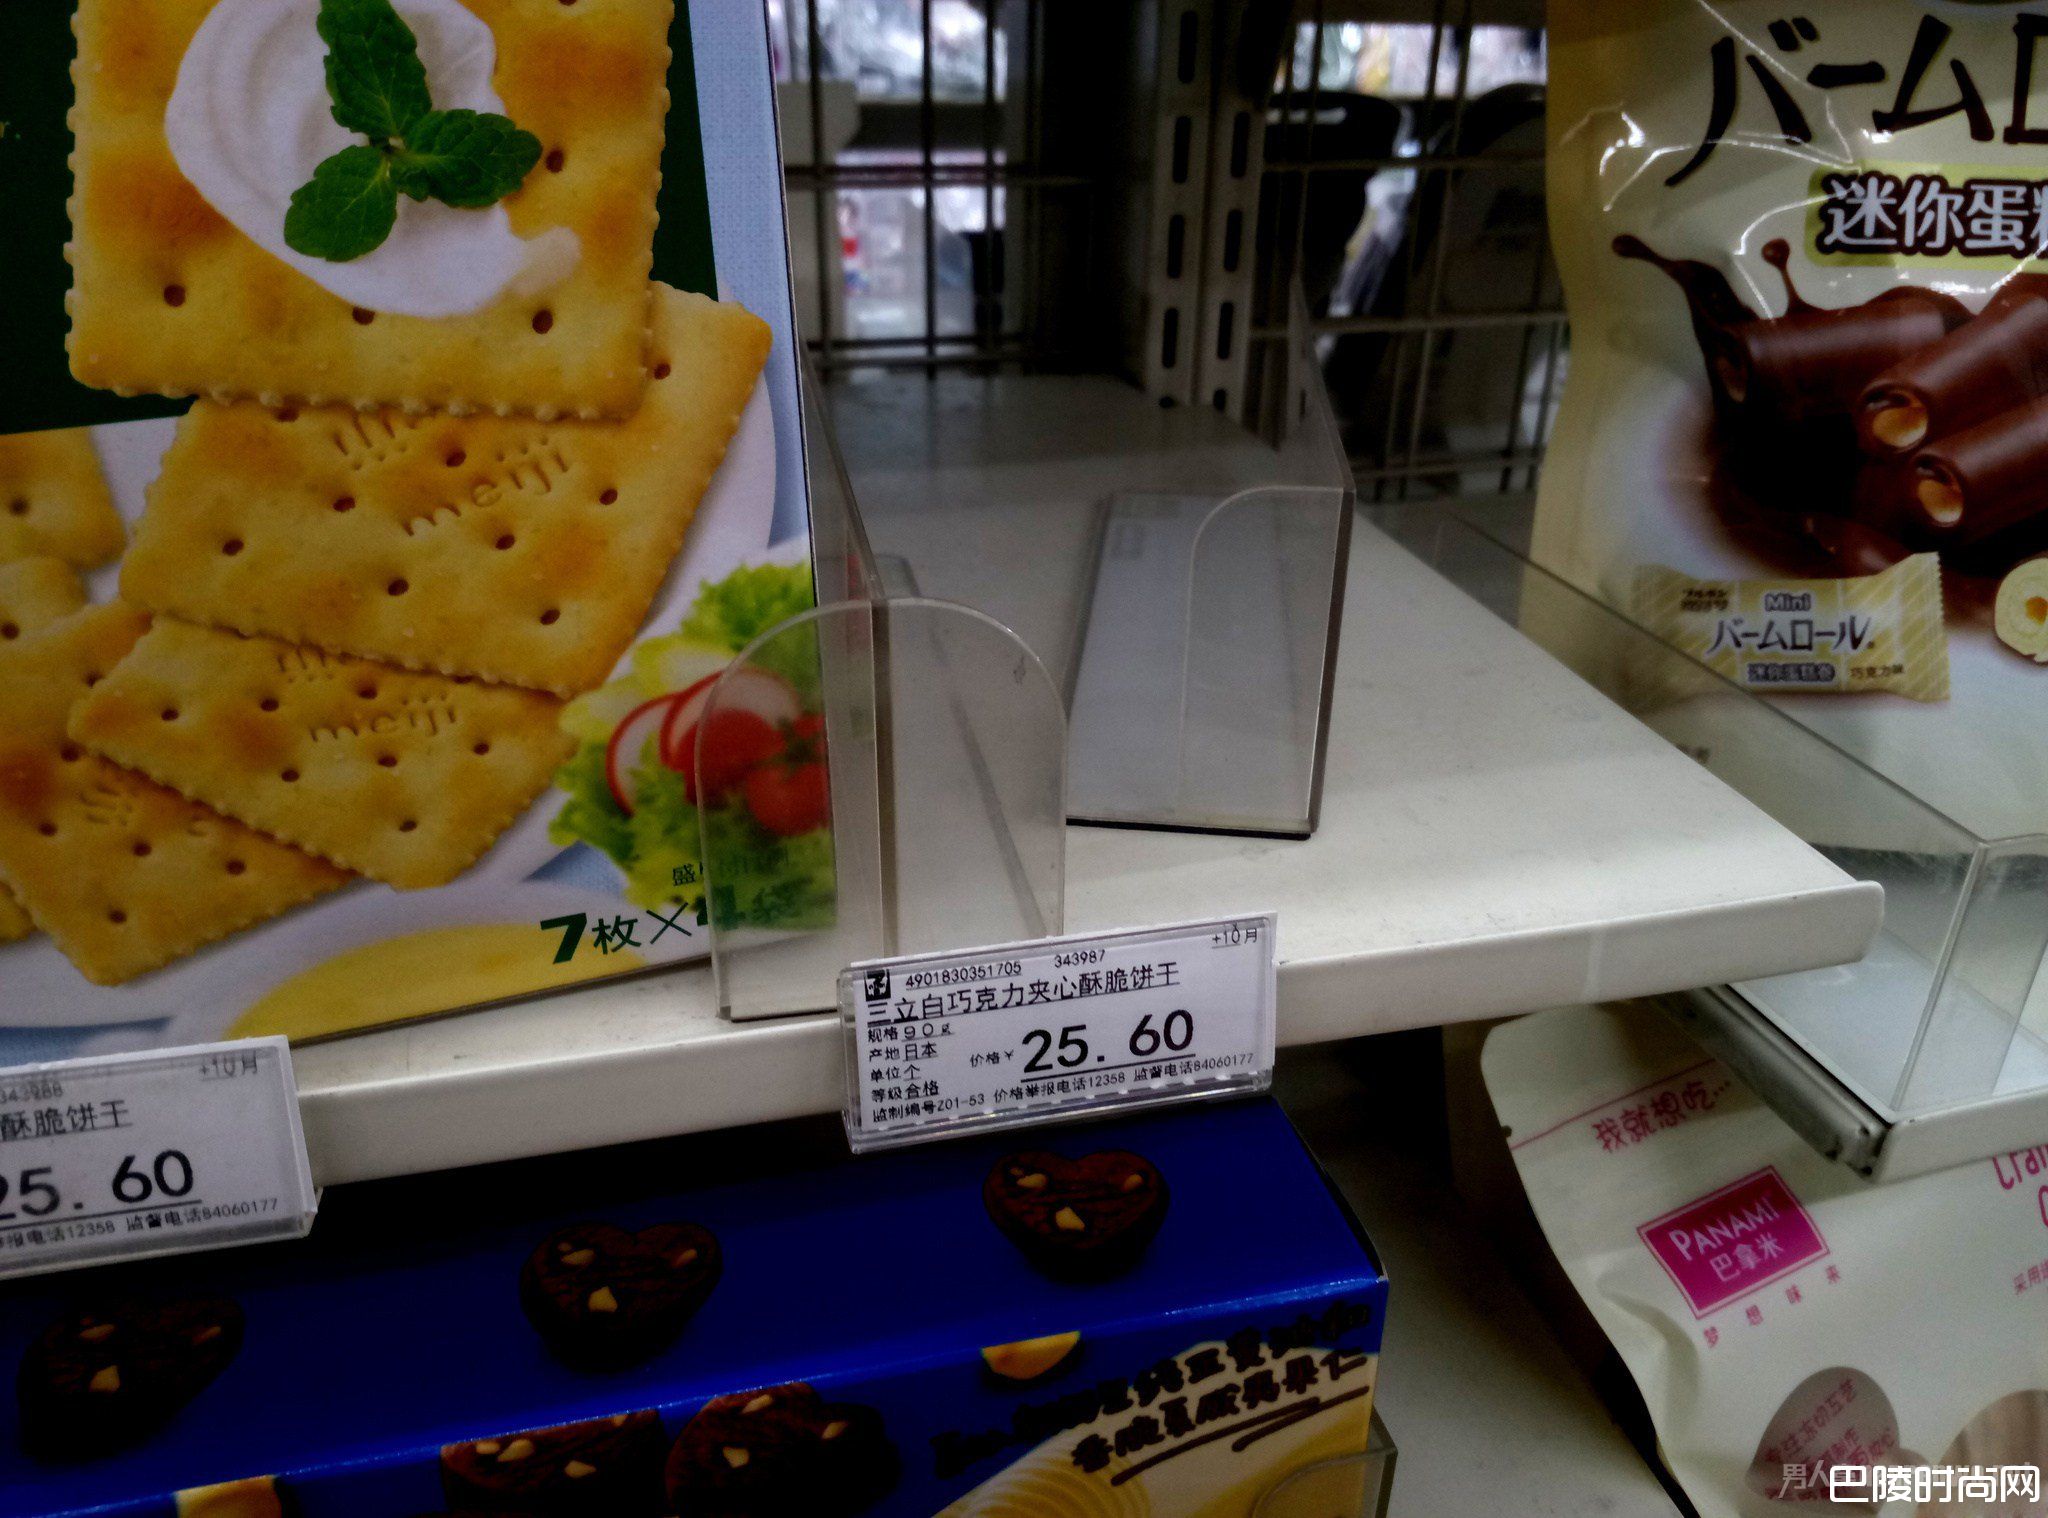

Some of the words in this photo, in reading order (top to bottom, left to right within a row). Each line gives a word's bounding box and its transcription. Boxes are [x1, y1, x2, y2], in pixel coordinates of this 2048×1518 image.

[1820, 172, 2048, 253] 迷你蛋
[1764, 592, 1812, 612] Mini
[905, 960, 1022, 989] 4901830351705
[1054, 949, 1106, 968] 343987
[1668, 1195, 1781, 1262] PANAMI
[1708, 1235, 1785, 1283] 巴拿米
